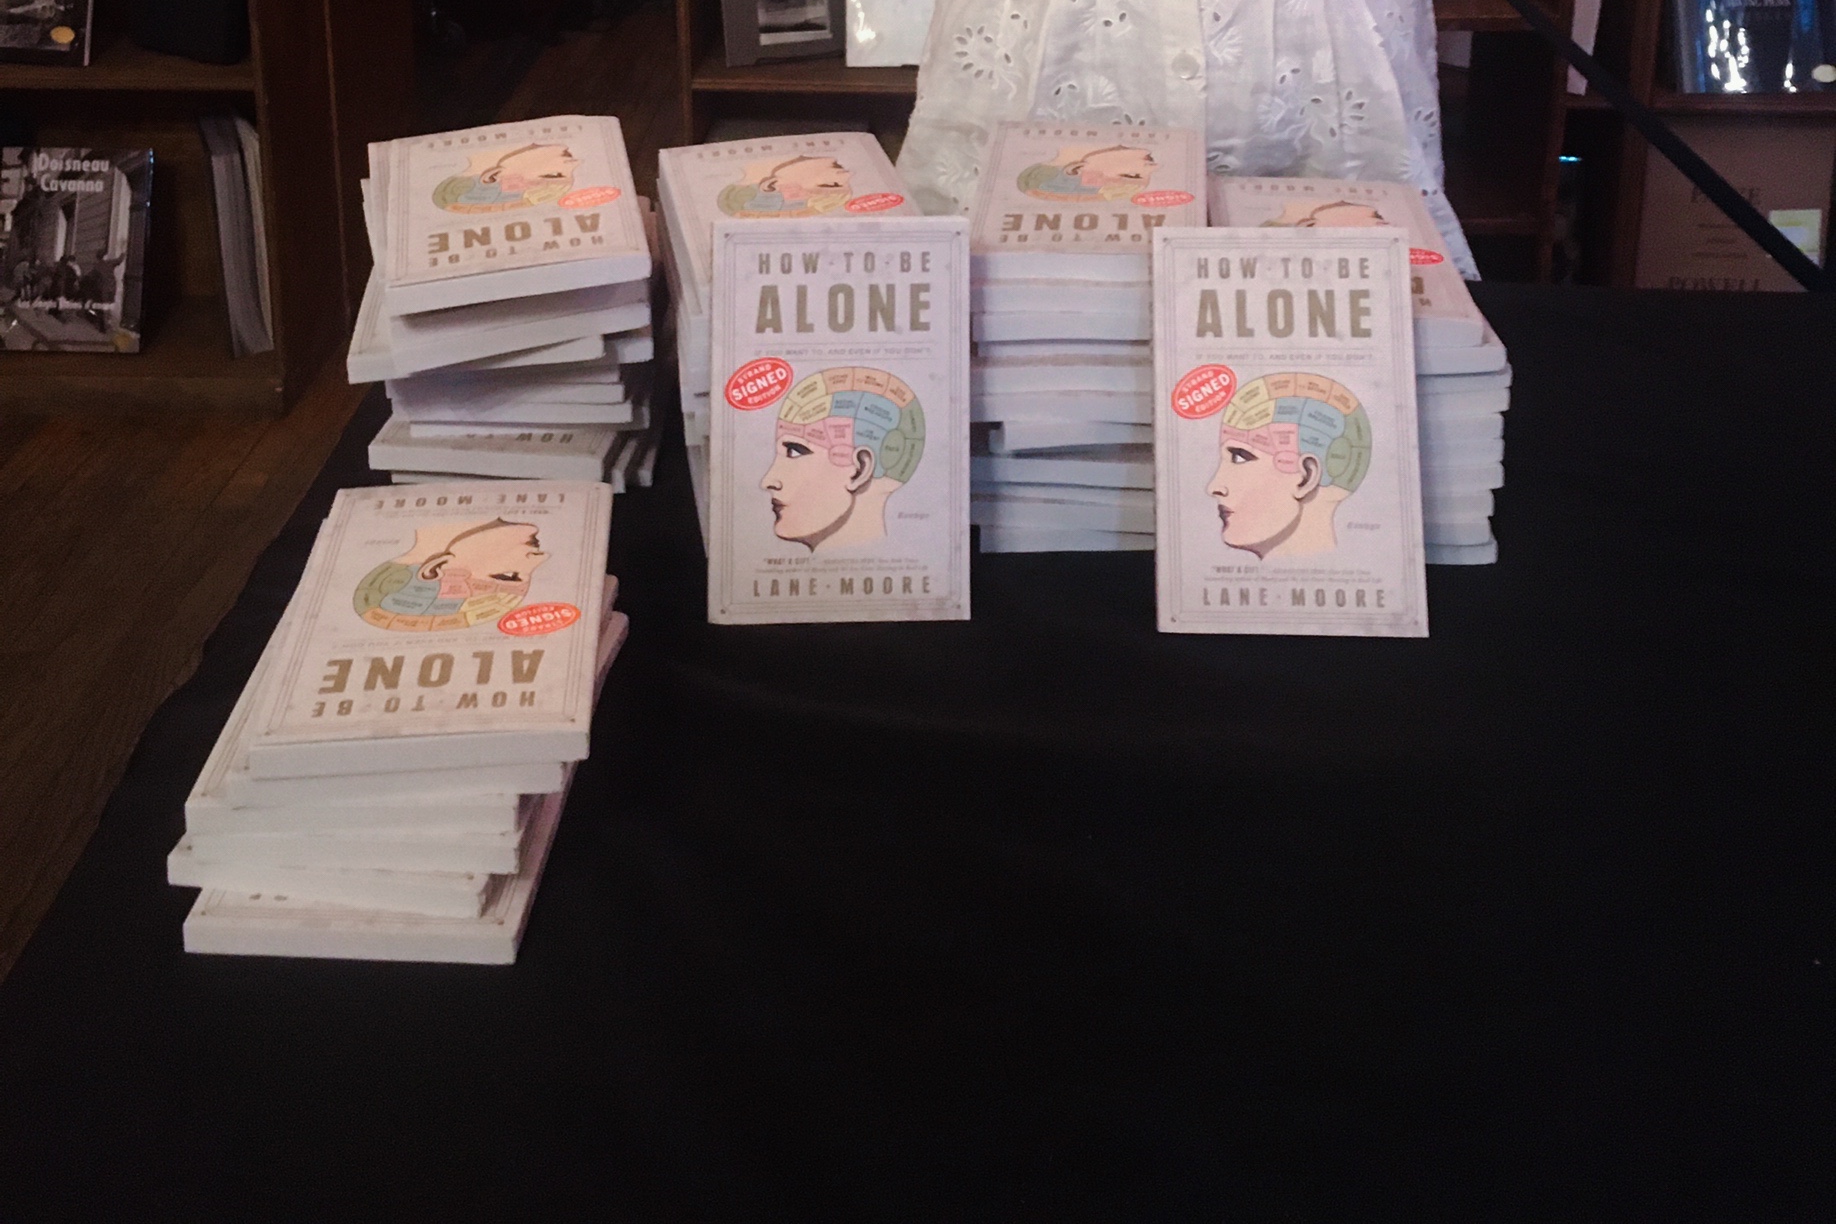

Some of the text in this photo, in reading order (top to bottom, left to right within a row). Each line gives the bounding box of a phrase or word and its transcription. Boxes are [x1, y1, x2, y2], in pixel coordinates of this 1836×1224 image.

[38, 153, 110, 172] Doisneau
[40, 173, 105, 192] Cavanna
[427, 212, 601, 256] ALONE
[1002, 213, 1167, 232] ALONE
[1051, 233, 1083, 243] TO
[1104, 233, 1153, 243] OW
[428, 234, 605, 269] HOW TO BE
[757, 251, 931, 275] HOW TO BE
[1197, 257, 1371, 280] HOW TO BE
[755, 282, 932, 334] ALONE
[1196, 288, 1373, 339] ALONE
[732, 367, 787, 401] SIGNED
[737, 363, 772, 385] STRAND
[1182, 370, 1214, 393] STRAND
[747, 384, 781, 405] EDITION
[1177, 373, 1231, 411] SIGNED
[1194, 390, 1227, 413] EDITION
[374, 492, 566, 510] LANE MOORE
[753, 575, 931, 598] LANE MOORE
[1203, 587, 1386, 608] LANE MOORE
[505, 608, 572, 630] SIGNED
[318, 648, 545, 695] ALONE
[311, 690, 536, 719] HOW TO BE
